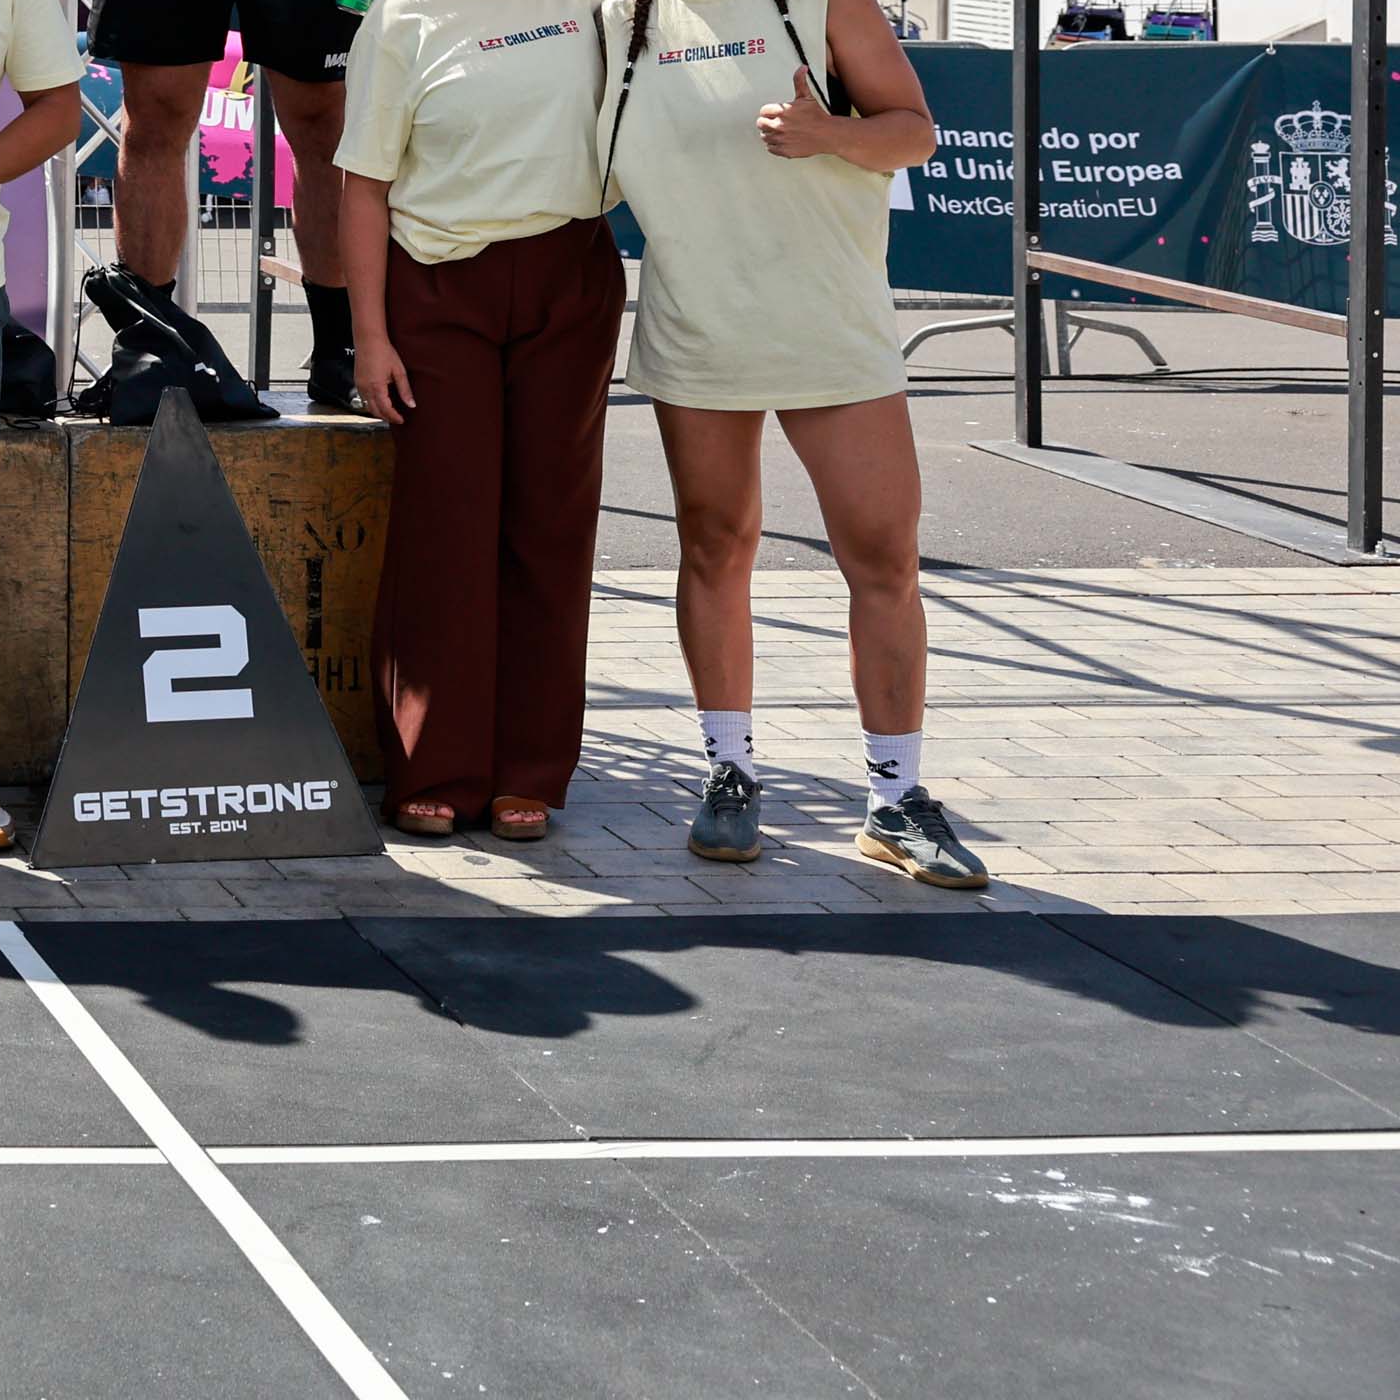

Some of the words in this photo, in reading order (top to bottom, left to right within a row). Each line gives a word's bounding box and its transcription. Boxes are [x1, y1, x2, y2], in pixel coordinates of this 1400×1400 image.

[479, 38, 503, 48] LZT
[504, 24, 565, 47] CHALLENGE
[659, 50, 683, 60] LZT
[685, 41, 746, 62] CHALLENGE
[748, 38, 764, 46] 20
[748, 46, 765, 54] 25
[934, 124, 1079, 152] inancdo
[1089, 129, 1140, 156] por
[923, 160, 948, 178] la
[1052, 159, 1182, 187] Europea
[928, 193, 1157, 217] NextGeerationEU
[138, 604, 254, 723] 2
[73, 781, 332, 822] GETSTRONG
[169, 822, 207, 836] EST.
[210, 820, 248, 833] 2014
